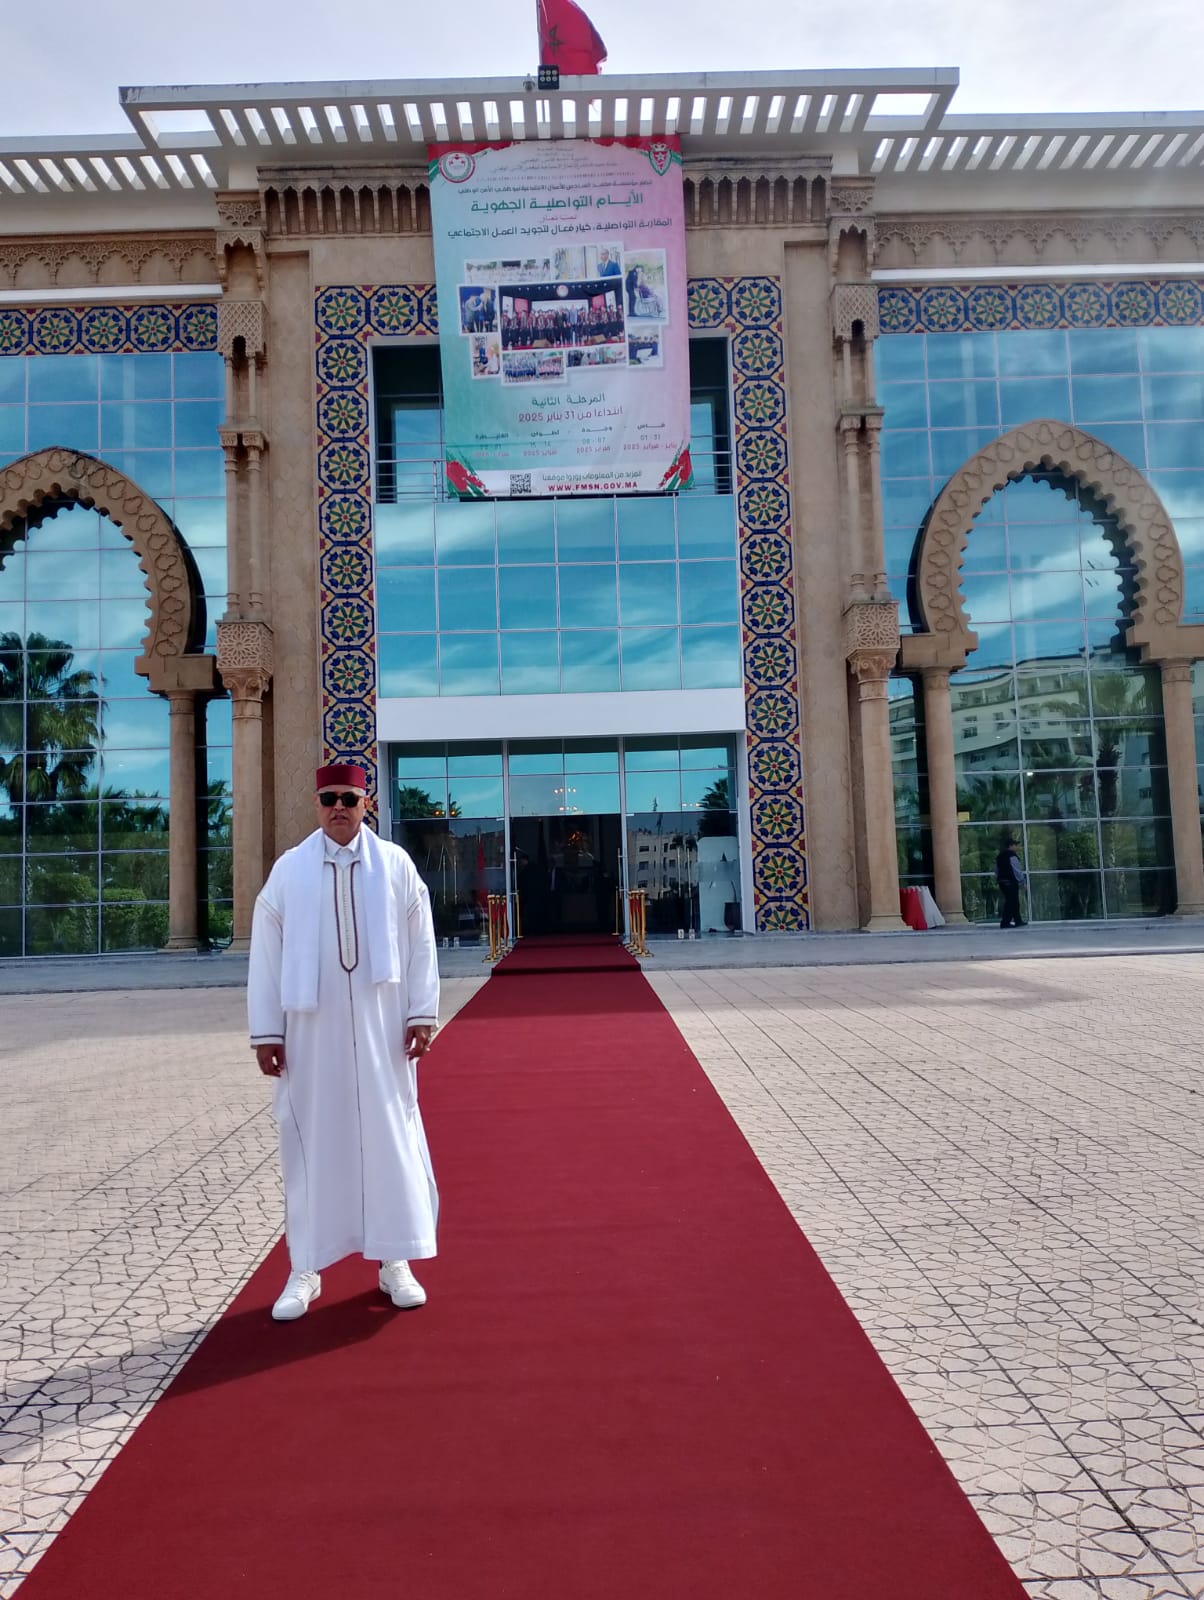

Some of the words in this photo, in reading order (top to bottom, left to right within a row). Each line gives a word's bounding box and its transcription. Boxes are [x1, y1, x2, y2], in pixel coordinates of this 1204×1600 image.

[529, 195, 593, 212] التواصلية
[596, 188, 643, 209] الأيام
[471, 198, 526, 214] الجهوية
[575, 223, 592, 233] خيار
[638, 216, 673, 228] المقاربة
[447, 227, 490, 240] الاجتماعي
[491, 227, 518, 239] العمل
[520, 225, 549, 237] لتجويد
[551, 224, 575, 236] فعال
[531, 396, 561, 409] الثانية
[566, 392, 606, 405] المرحلة
[518, 412, 544, 423] 2025
[546, 411, 562, 423] يناير
[565, 411, 575, 420] 31
[577, 411, 592, 421] من
[548, 481, 639, 492] WWW.FMSN.GOV.MA
